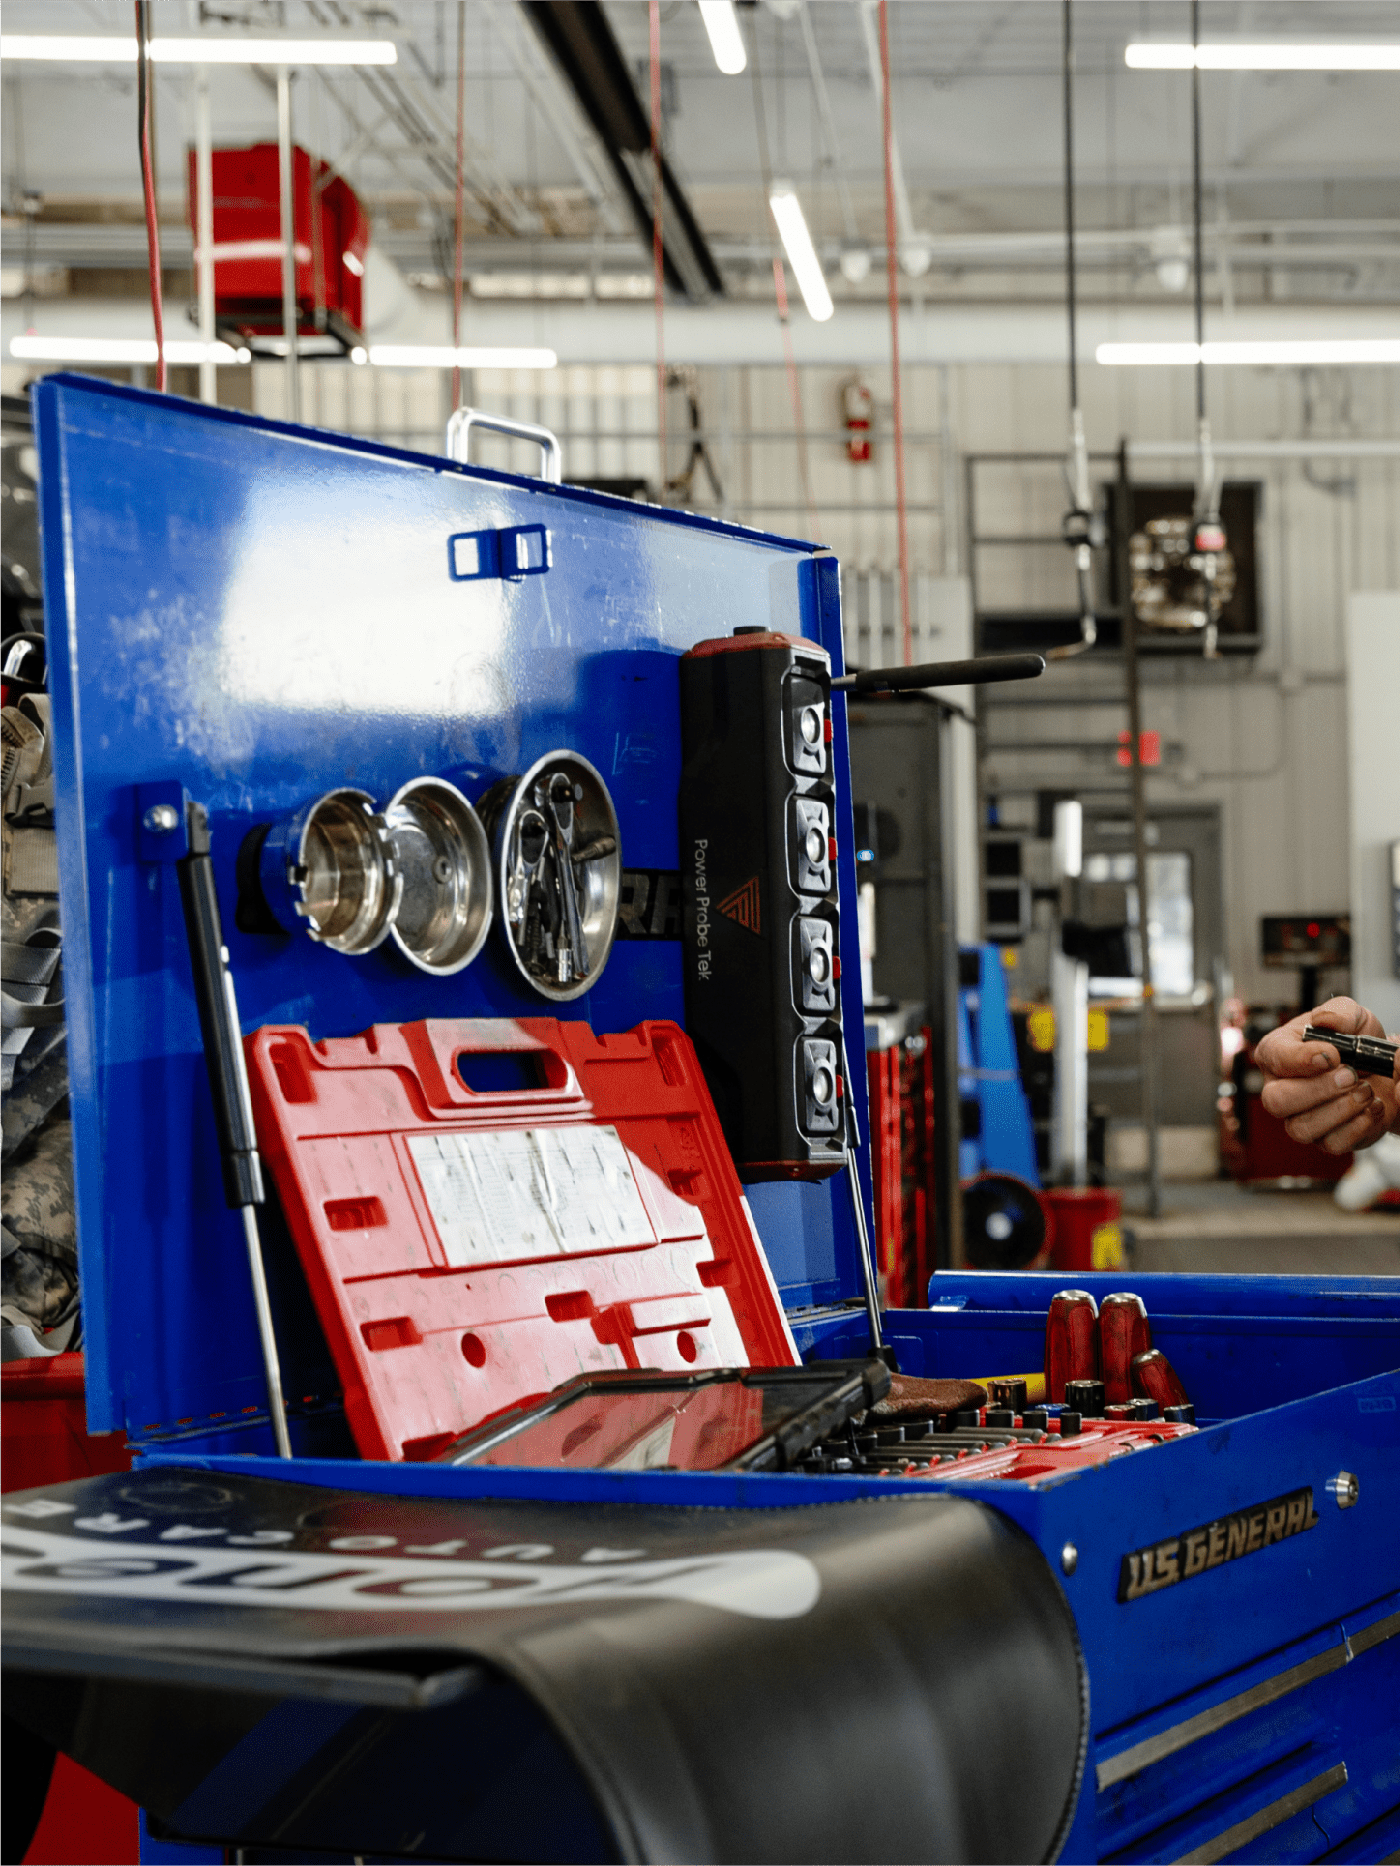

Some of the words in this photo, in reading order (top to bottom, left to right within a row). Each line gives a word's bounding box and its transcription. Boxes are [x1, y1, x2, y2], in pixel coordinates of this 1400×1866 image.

[694, 838, 709, 893] Power
[696, 896, 711, 947] Probe
[697, 949, 713, 981] Tek
[327, 1534, 647, 1563] AUTO
[1183, 1491, 1320, 1577] GENERAL
